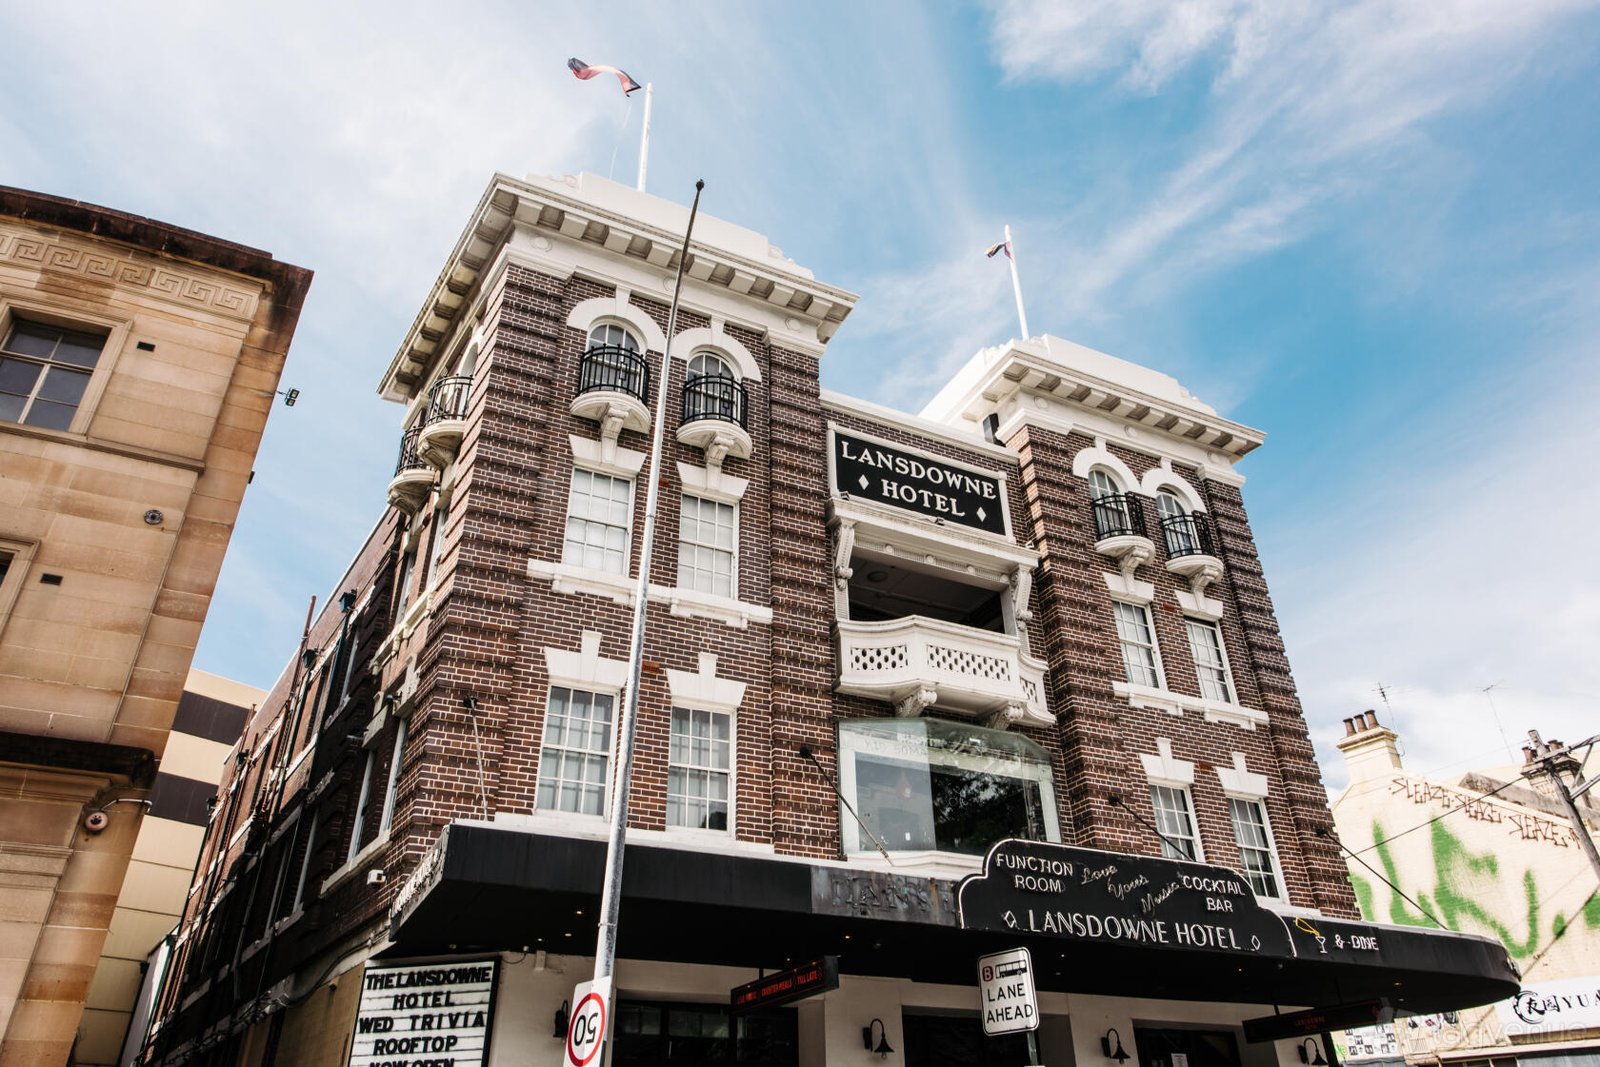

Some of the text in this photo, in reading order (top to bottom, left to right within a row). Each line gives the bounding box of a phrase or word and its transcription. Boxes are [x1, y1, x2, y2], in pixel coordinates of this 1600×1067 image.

[841, 441, 997, 500] LANSDOWNE
[881, 478, 966, 517] HOTEL
[996, 853, 1074, 877] FUNCTION
[1015, 875, 1062, 893] ROOM
[1182, 874, 1246, 896] COCKTAIL
[1207, 897, 1234, 914] BAR
[1028, 909, 1241, 951] LANSDOWNE HOTEL
[366, 967, 492, 990] THE LANSDOWNE
[393, 990, 454, 1010] HOTEL
[988, 983, 1025, 1002] LANE
[358, 1011, 485, 1034] WED TRIVIA
[986, 1004, 1034, 1024] AHEAD
[574, 1012, 598, 1047] 50
[373, 1035, 458, 1056] ROOFTOP
